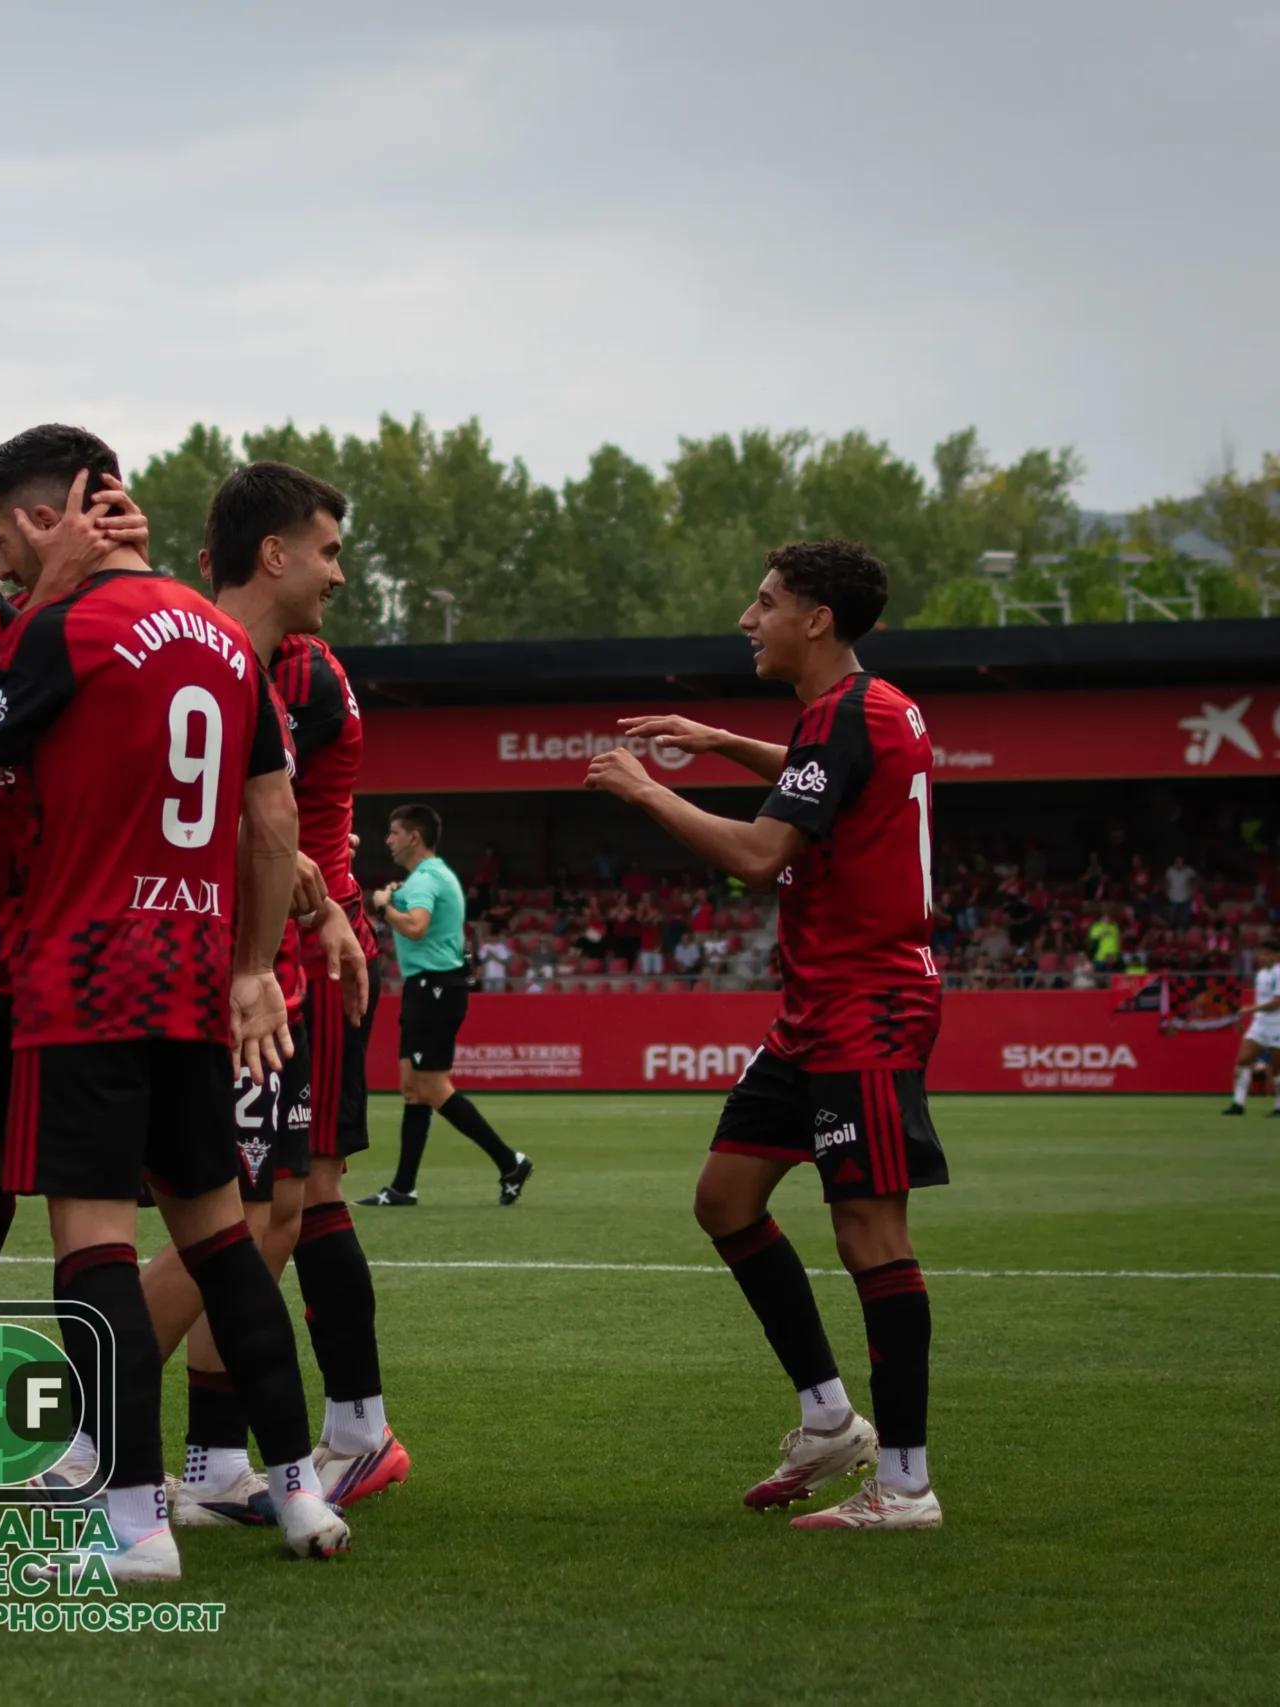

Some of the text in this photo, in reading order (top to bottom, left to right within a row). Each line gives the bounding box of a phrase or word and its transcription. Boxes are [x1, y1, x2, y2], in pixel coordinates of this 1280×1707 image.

[113, 608, 246, 680] I. UNZUETA
[498, 733, 648, 761] E.Leclerc
[162, 685, 222, 848] 9
[908, 772, 933, 920] 1
[129, 875, 222, 917] IZADI
[453, 1045, 514, 1060] PACIOS
[645, 1045, 754, 1081] FRAN
[1002, 1044, 1138, 1069] SKODA
[1022, 1071, 1117, 1088] Ural Motor
[814, 1123, 856, 1151] lucoil
[900, 1447, 911, 1475] SIGN
